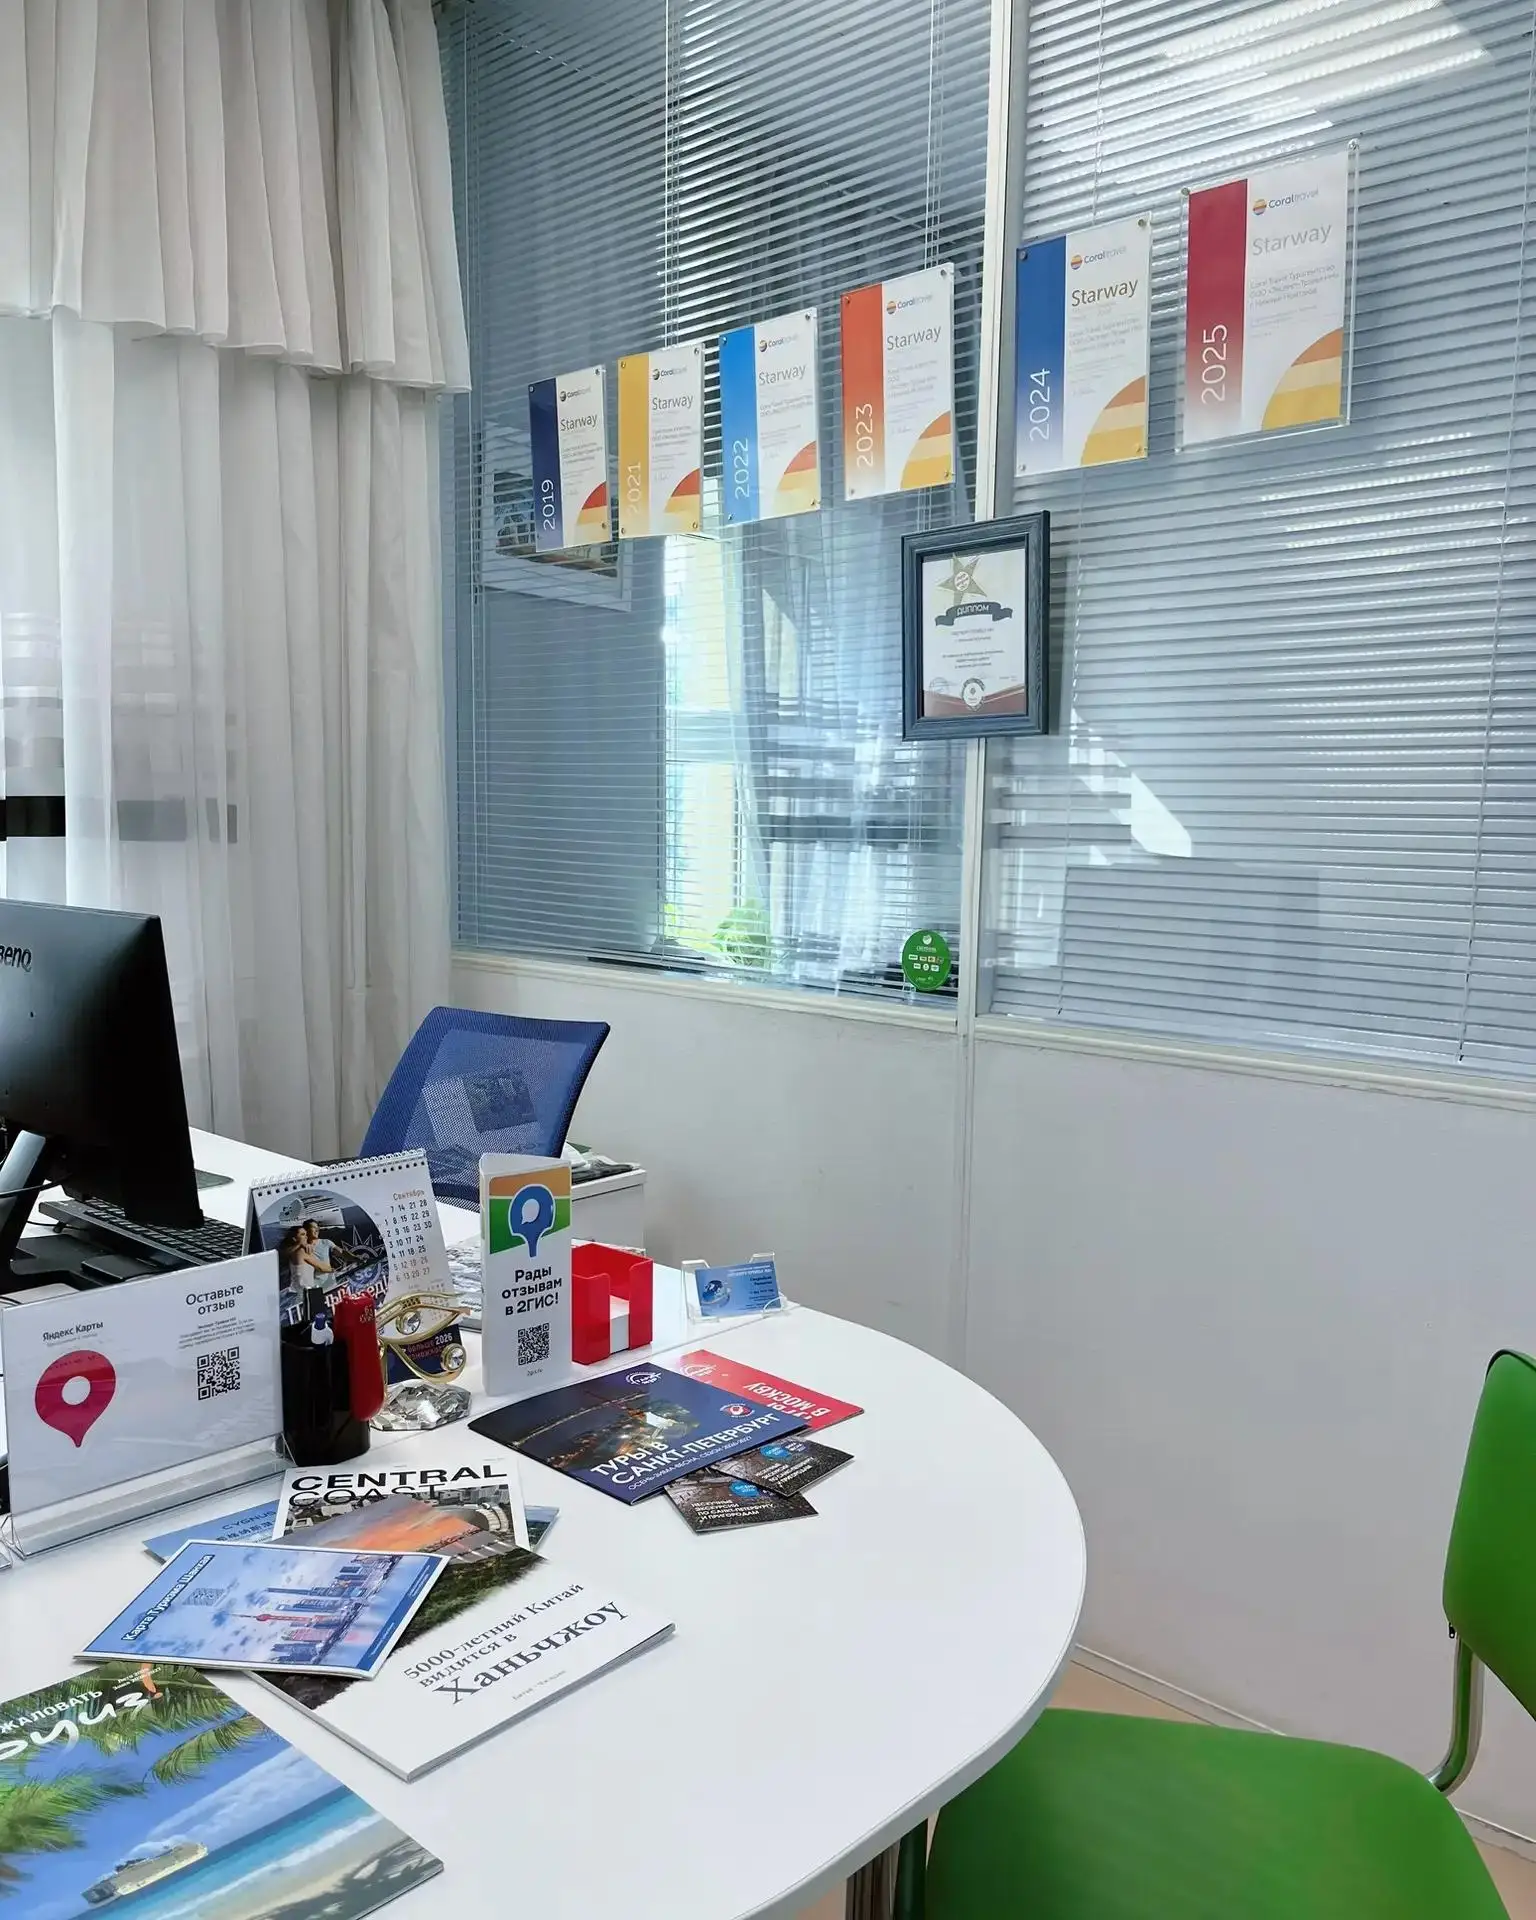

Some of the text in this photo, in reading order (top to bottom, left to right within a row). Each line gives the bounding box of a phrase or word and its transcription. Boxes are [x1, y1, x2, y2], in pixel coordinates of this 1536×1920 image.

[1252, 224, 1332, 256] Starway
[1071, 279, 1138, 307] Starway
[886, 326, 941, 351] Starway
[759, 364, 806, 386] Starway
[1201, 324, 1228, 404] 2025
[653, 395, 693, 410] Starway
[1030, 368, 1050, 441] 2024
[560, 414, 597, 432] Starway
[856, 403, 873, 467] 2023
[734, 438, 749, 499] 2022
[627, 462, 641, 515] 2021
[541, 479, 555, 531] 2019
[398, 1204, 405, 1212] 14
[400, 1214, 408, 1223] 15
[411, 1212, 419, 1220] 22
[421, 1210, 430, 1218] 29
[402, 1226, 410, 1234] 16
[413, 1223, 421, 1232] 23
[424, 1221, 432, 1229] 30
[405, 1236, 412, 1244] 17
[399, 1250, 405, 1258] 11
[408, 1248, 415, 1256] 18
[418, 1245, 426, 1254] 25
[515, 1266, 552, 1283] Рады
[185, 1285, 244, 1305] Оставьте
[501, 1278, 562, 1299] отзывам
[197, 1299, 236, 1315] отзыв
[505, 1292, 558, 1316] в 2ГИС!
[42, 1327, 74, 1341] Яндекс
[75, 1322, 104, 1334] Карты
[435, 1333, 452, 1345] 2026
[743, 1382, 814, 1413] МОСКВУ
[590, 1440, 669, 1476] ТУРЫ В
[611, 1413, 781, 1484] САНКТ-ПЕТЕРБУРГ
[291, 1464, 507, 1491] CENTRAL
[222, 1511, 276, 1530] CYGNUS
[122, 1616, 153, 1641] Карта
[404, 1611, 526, 1680] 5000-летний
[525, 1582, 585, 1616] Китай
[420, 1632, 518, 1688] видится в
[432, 1601, 630, 1704] Ханьчжоу
